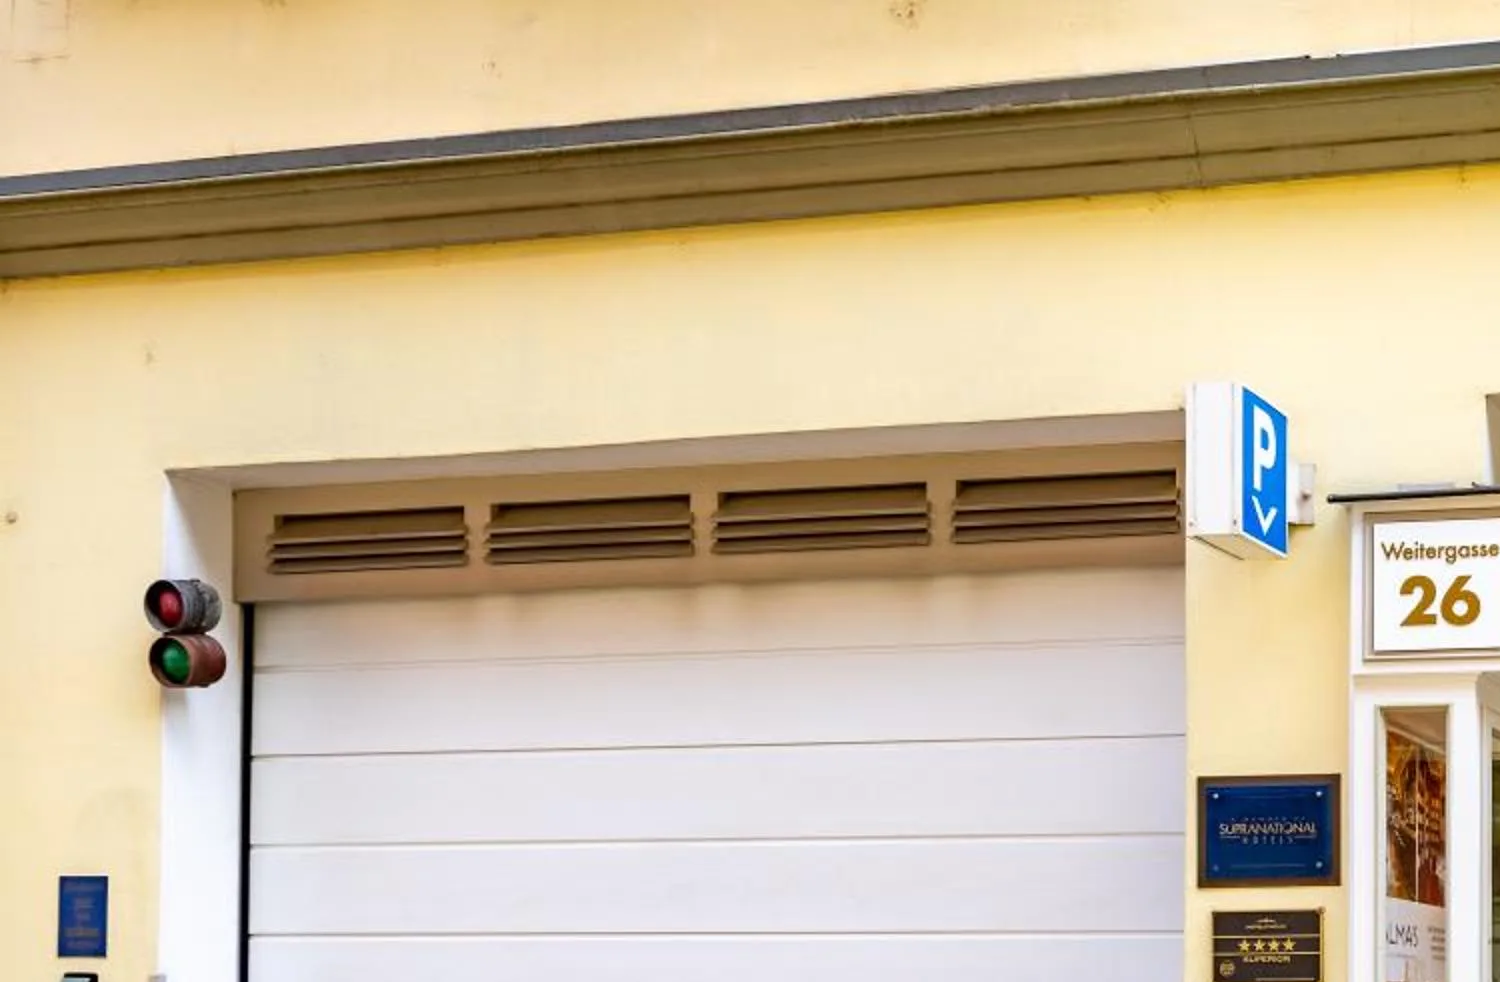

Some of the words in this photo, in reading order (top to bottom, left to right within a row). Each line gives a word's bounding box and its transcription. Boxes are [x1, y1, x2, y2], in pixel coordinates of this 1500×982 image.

[1253, 404, 1277, 491] P
[1380, 539, 1500, 564] Weitergasse
[1399, 574, 1482, 627] 26
[1218, 822, 1317, 835] SUPRANATIONAL
